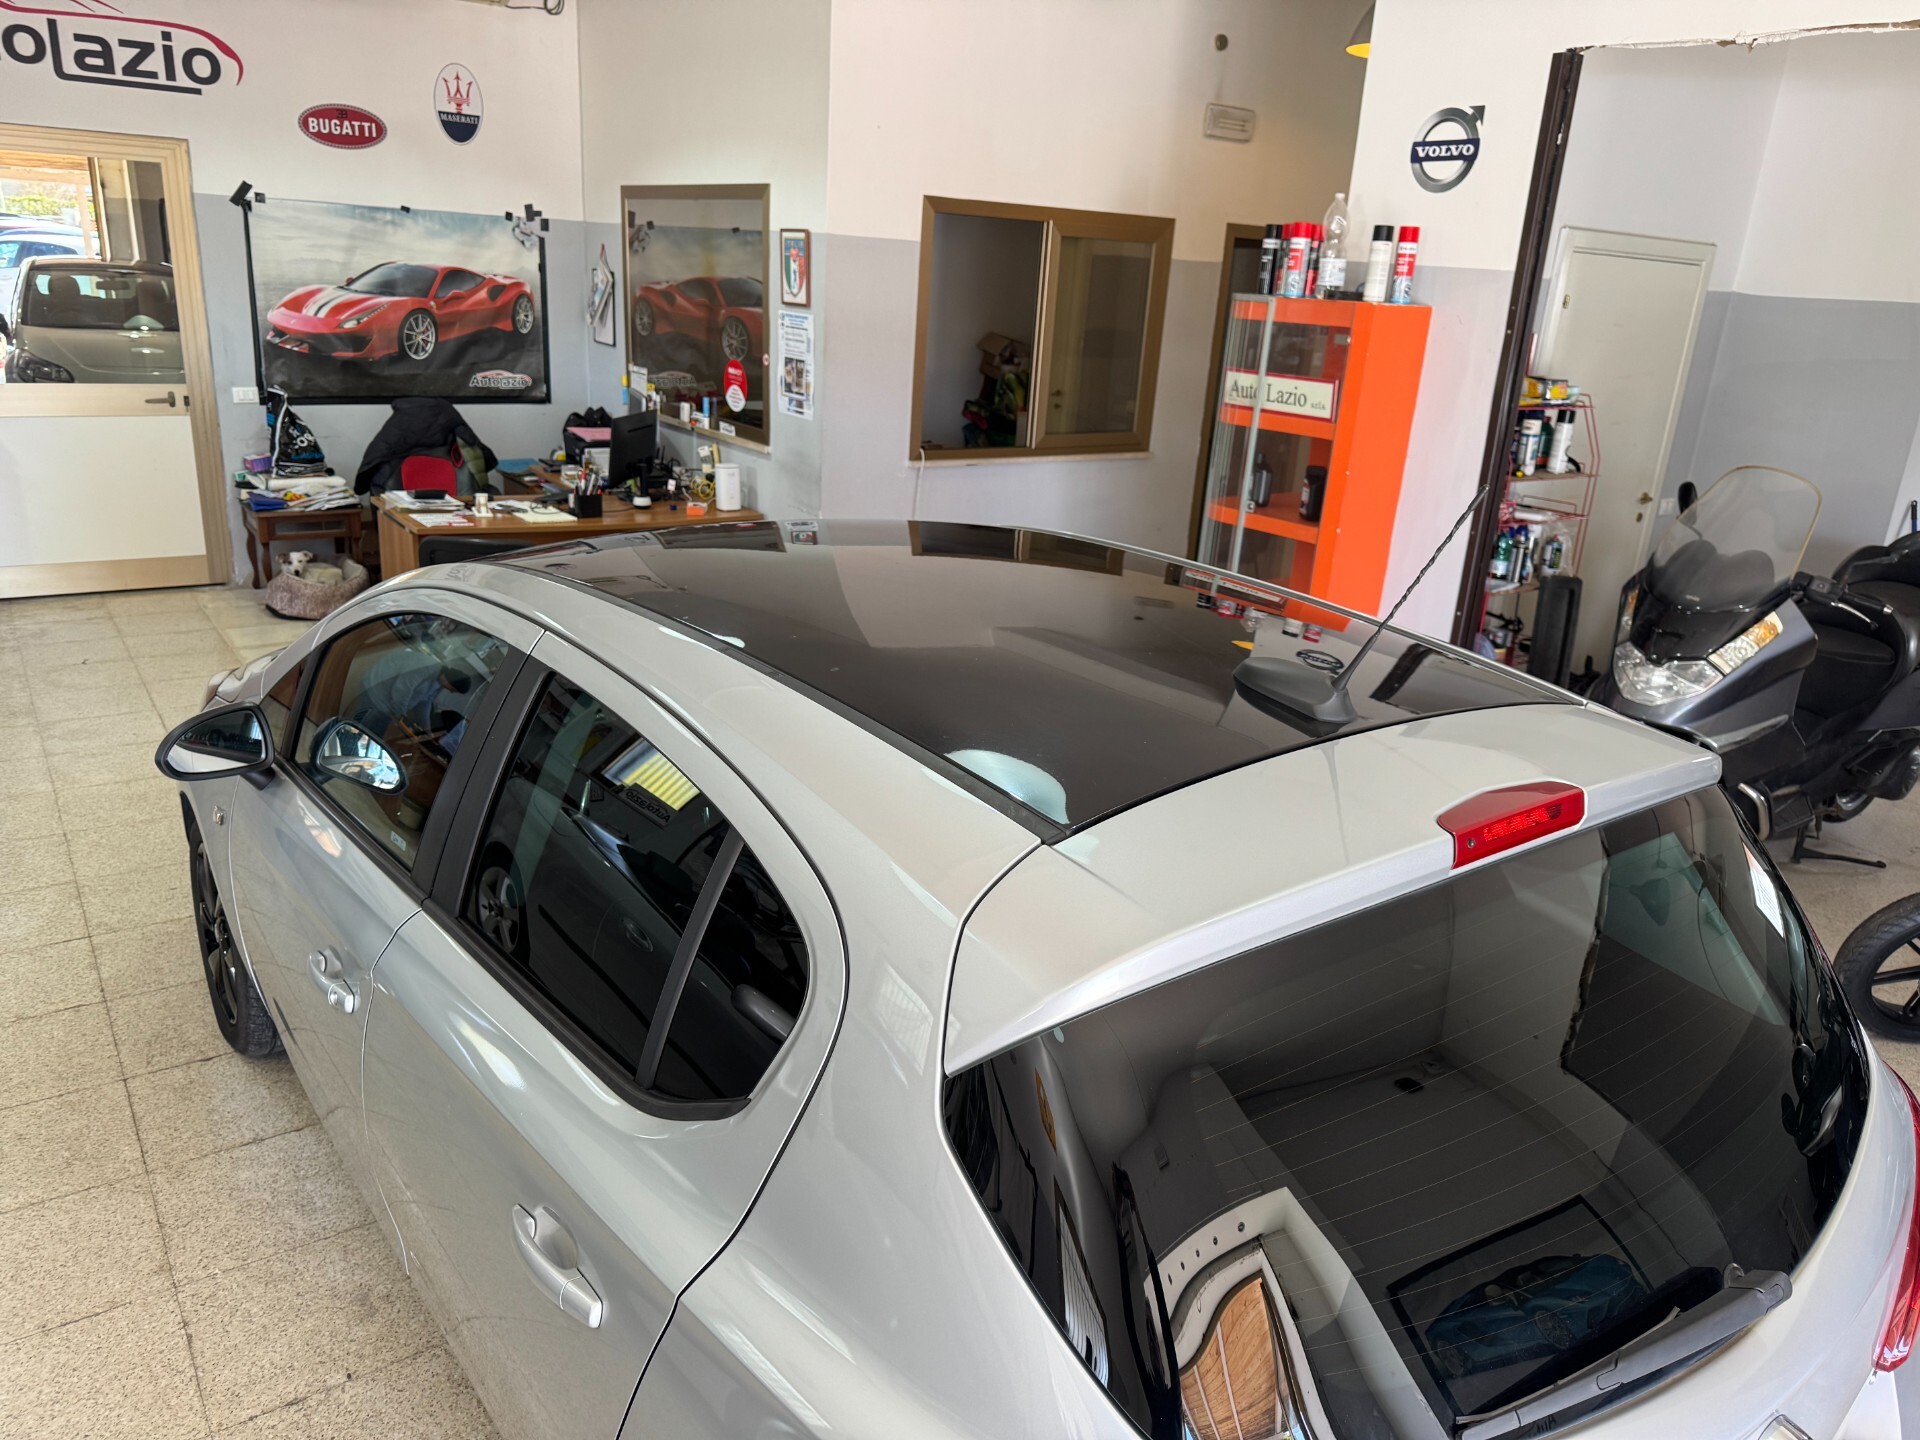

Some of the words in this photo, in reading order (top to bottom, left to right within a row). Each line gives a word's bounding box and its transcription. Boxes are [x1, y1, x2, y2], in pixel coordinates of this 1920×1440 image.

[0, 18, 221, 95] oLazio
[307, 117, 377, 138] BUGATTI
[440, 112, 480, 125] MASERATI
[1415, 144, 1475, 158] VOLVO
[1266, 383, 1307, 407] Lazio
